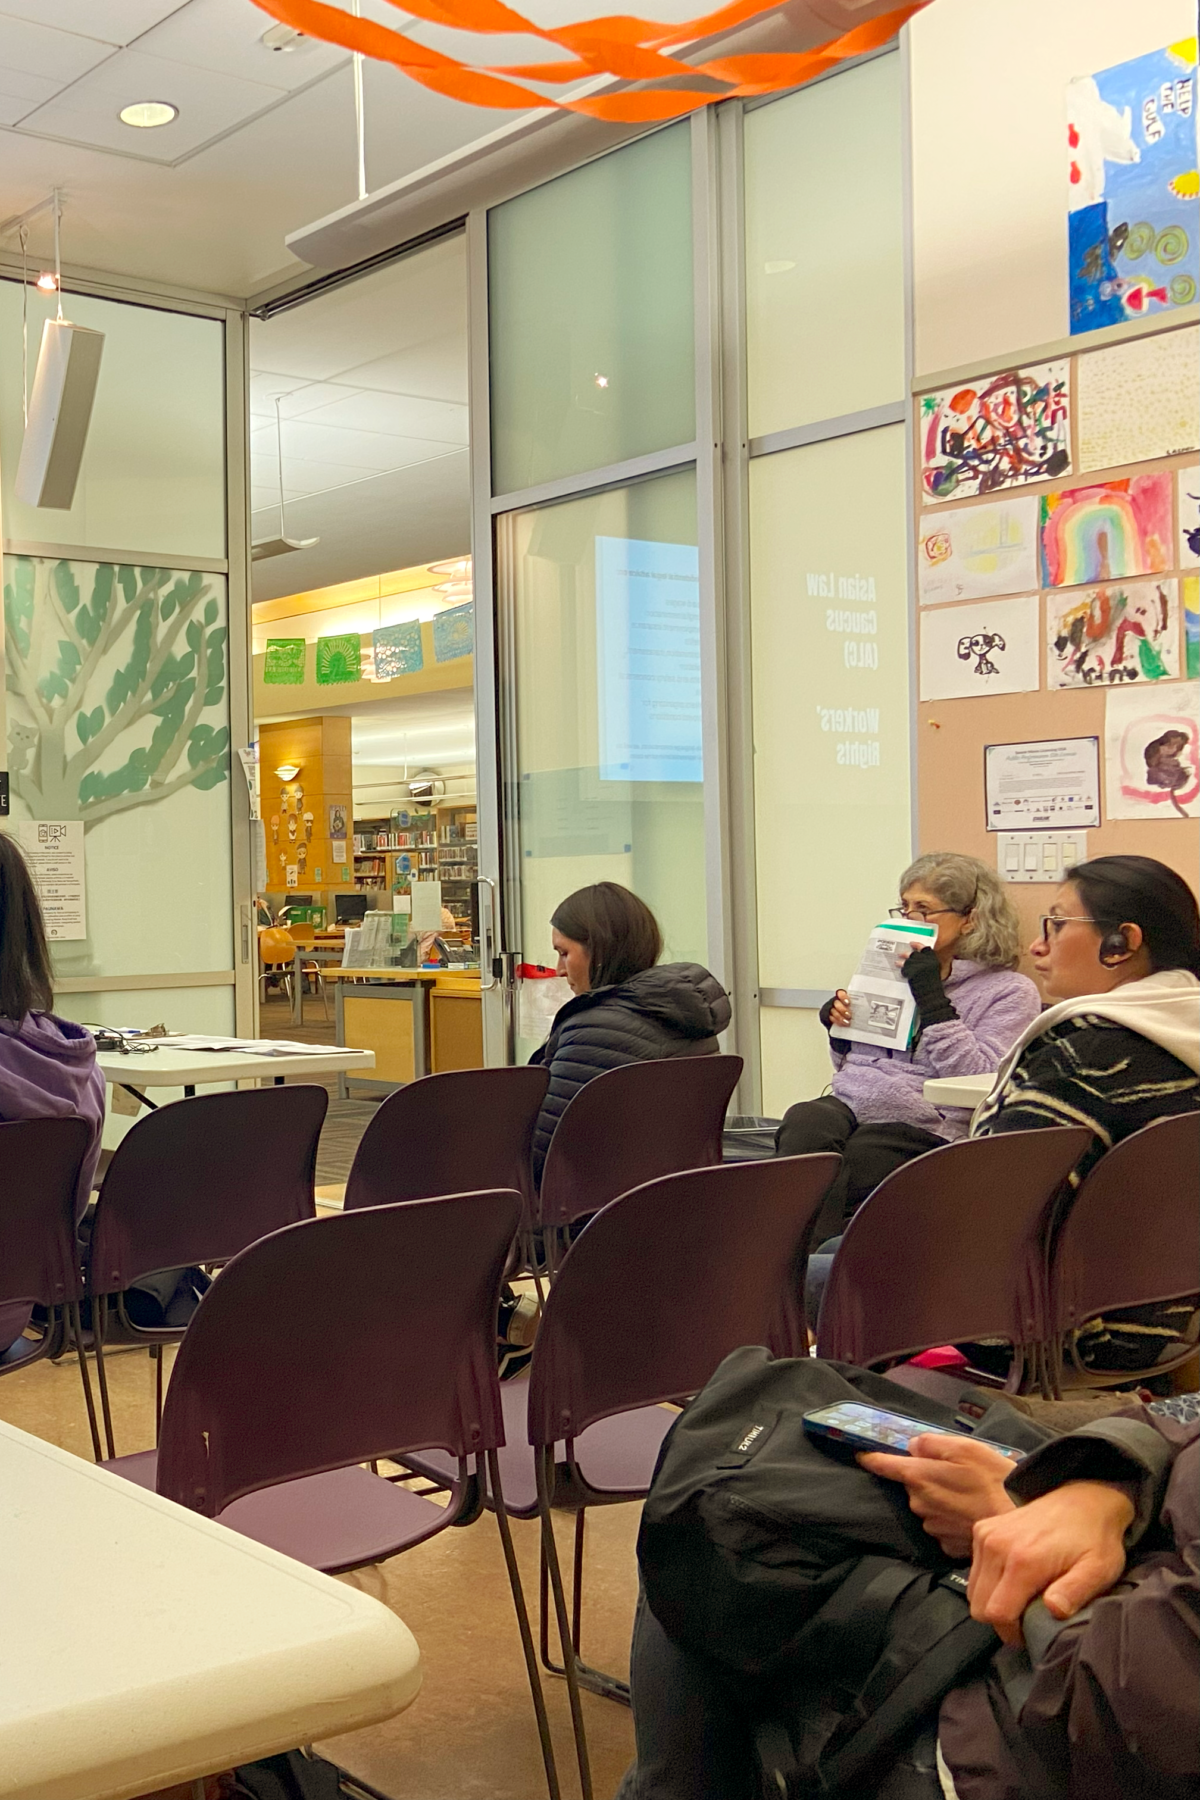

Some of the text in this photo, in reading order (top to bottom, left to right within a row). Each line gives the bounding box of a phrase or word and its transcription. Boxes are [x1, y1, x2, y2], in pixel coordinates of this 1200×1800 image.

[1163, 86, 1174, 109] THE
[1177, 78, 1192, 115] HELP
[1144, 99, 1161, 139] GULF
